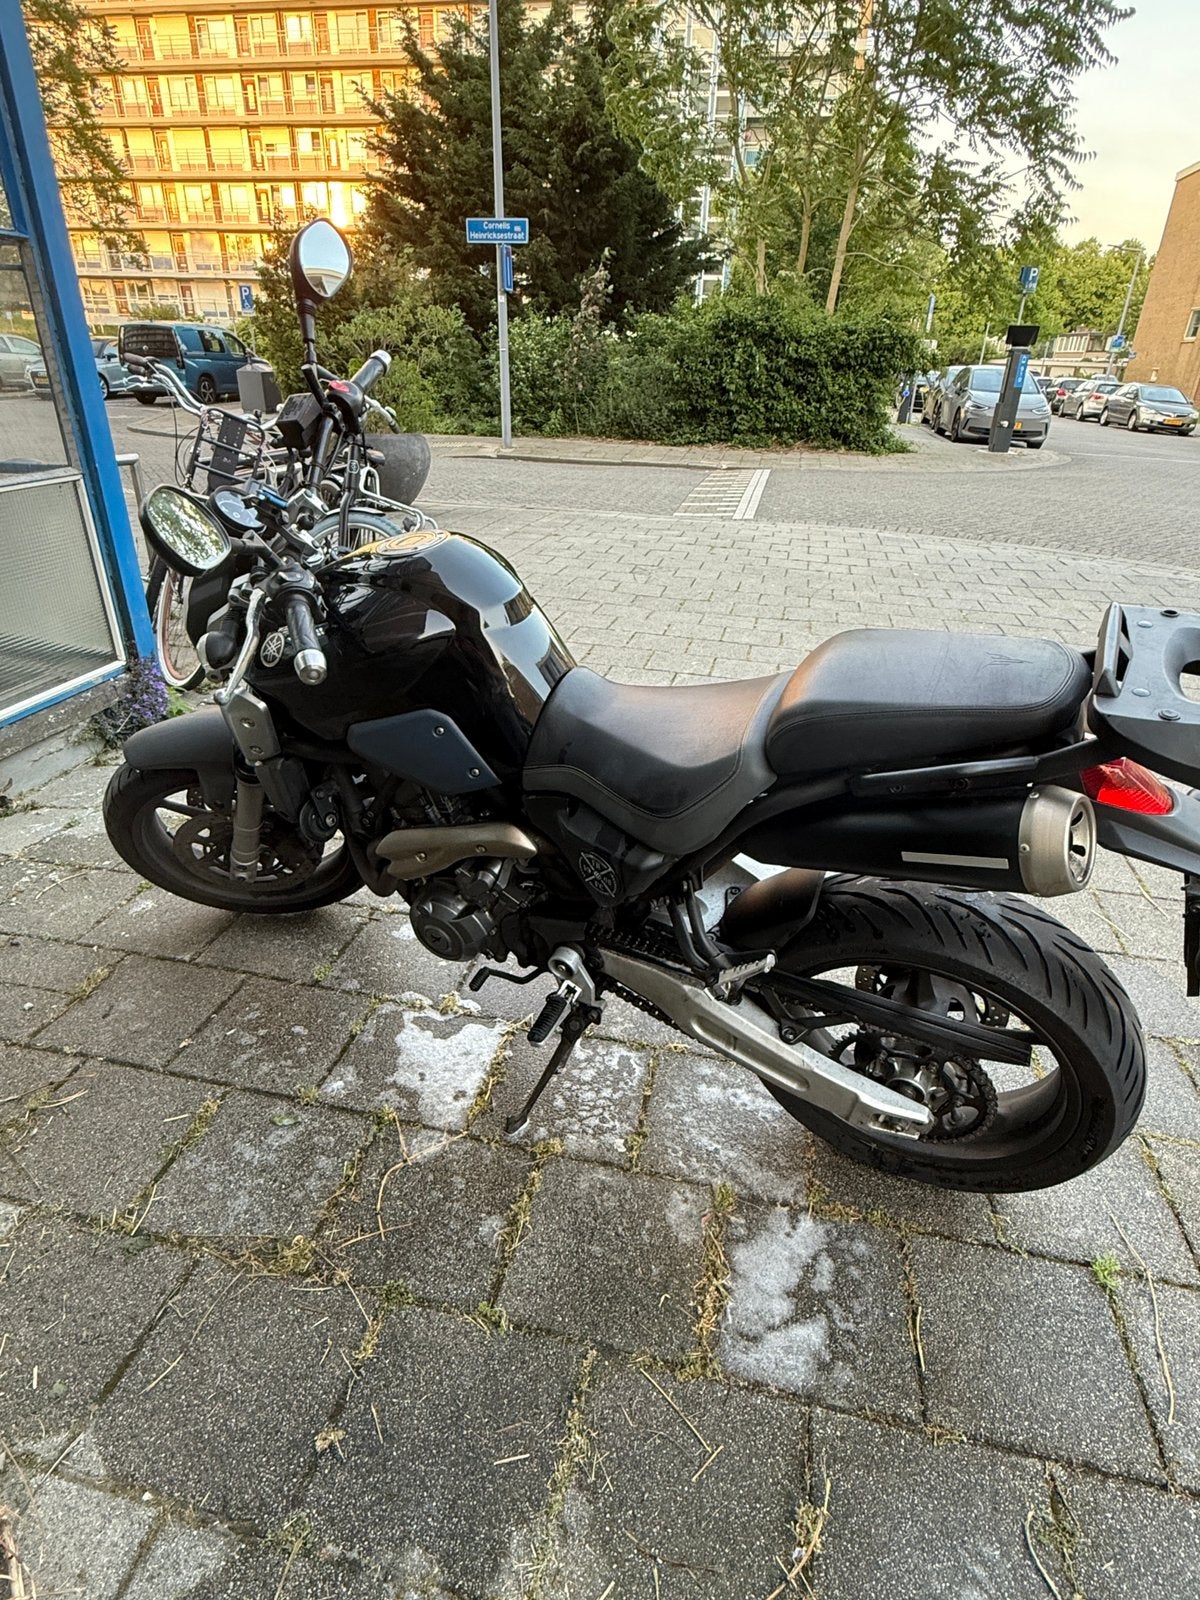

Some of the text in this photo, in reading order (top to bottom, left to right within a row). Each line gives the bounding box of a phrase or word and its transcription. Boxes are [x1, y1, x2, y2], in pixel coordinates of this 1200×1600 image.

[483, 221, 511, 230] Cornelis
[470, 231, 525, 240] Heinricksestraat
[1029, 267, 1039, 281] P
[241, 286, 250, 300] P
